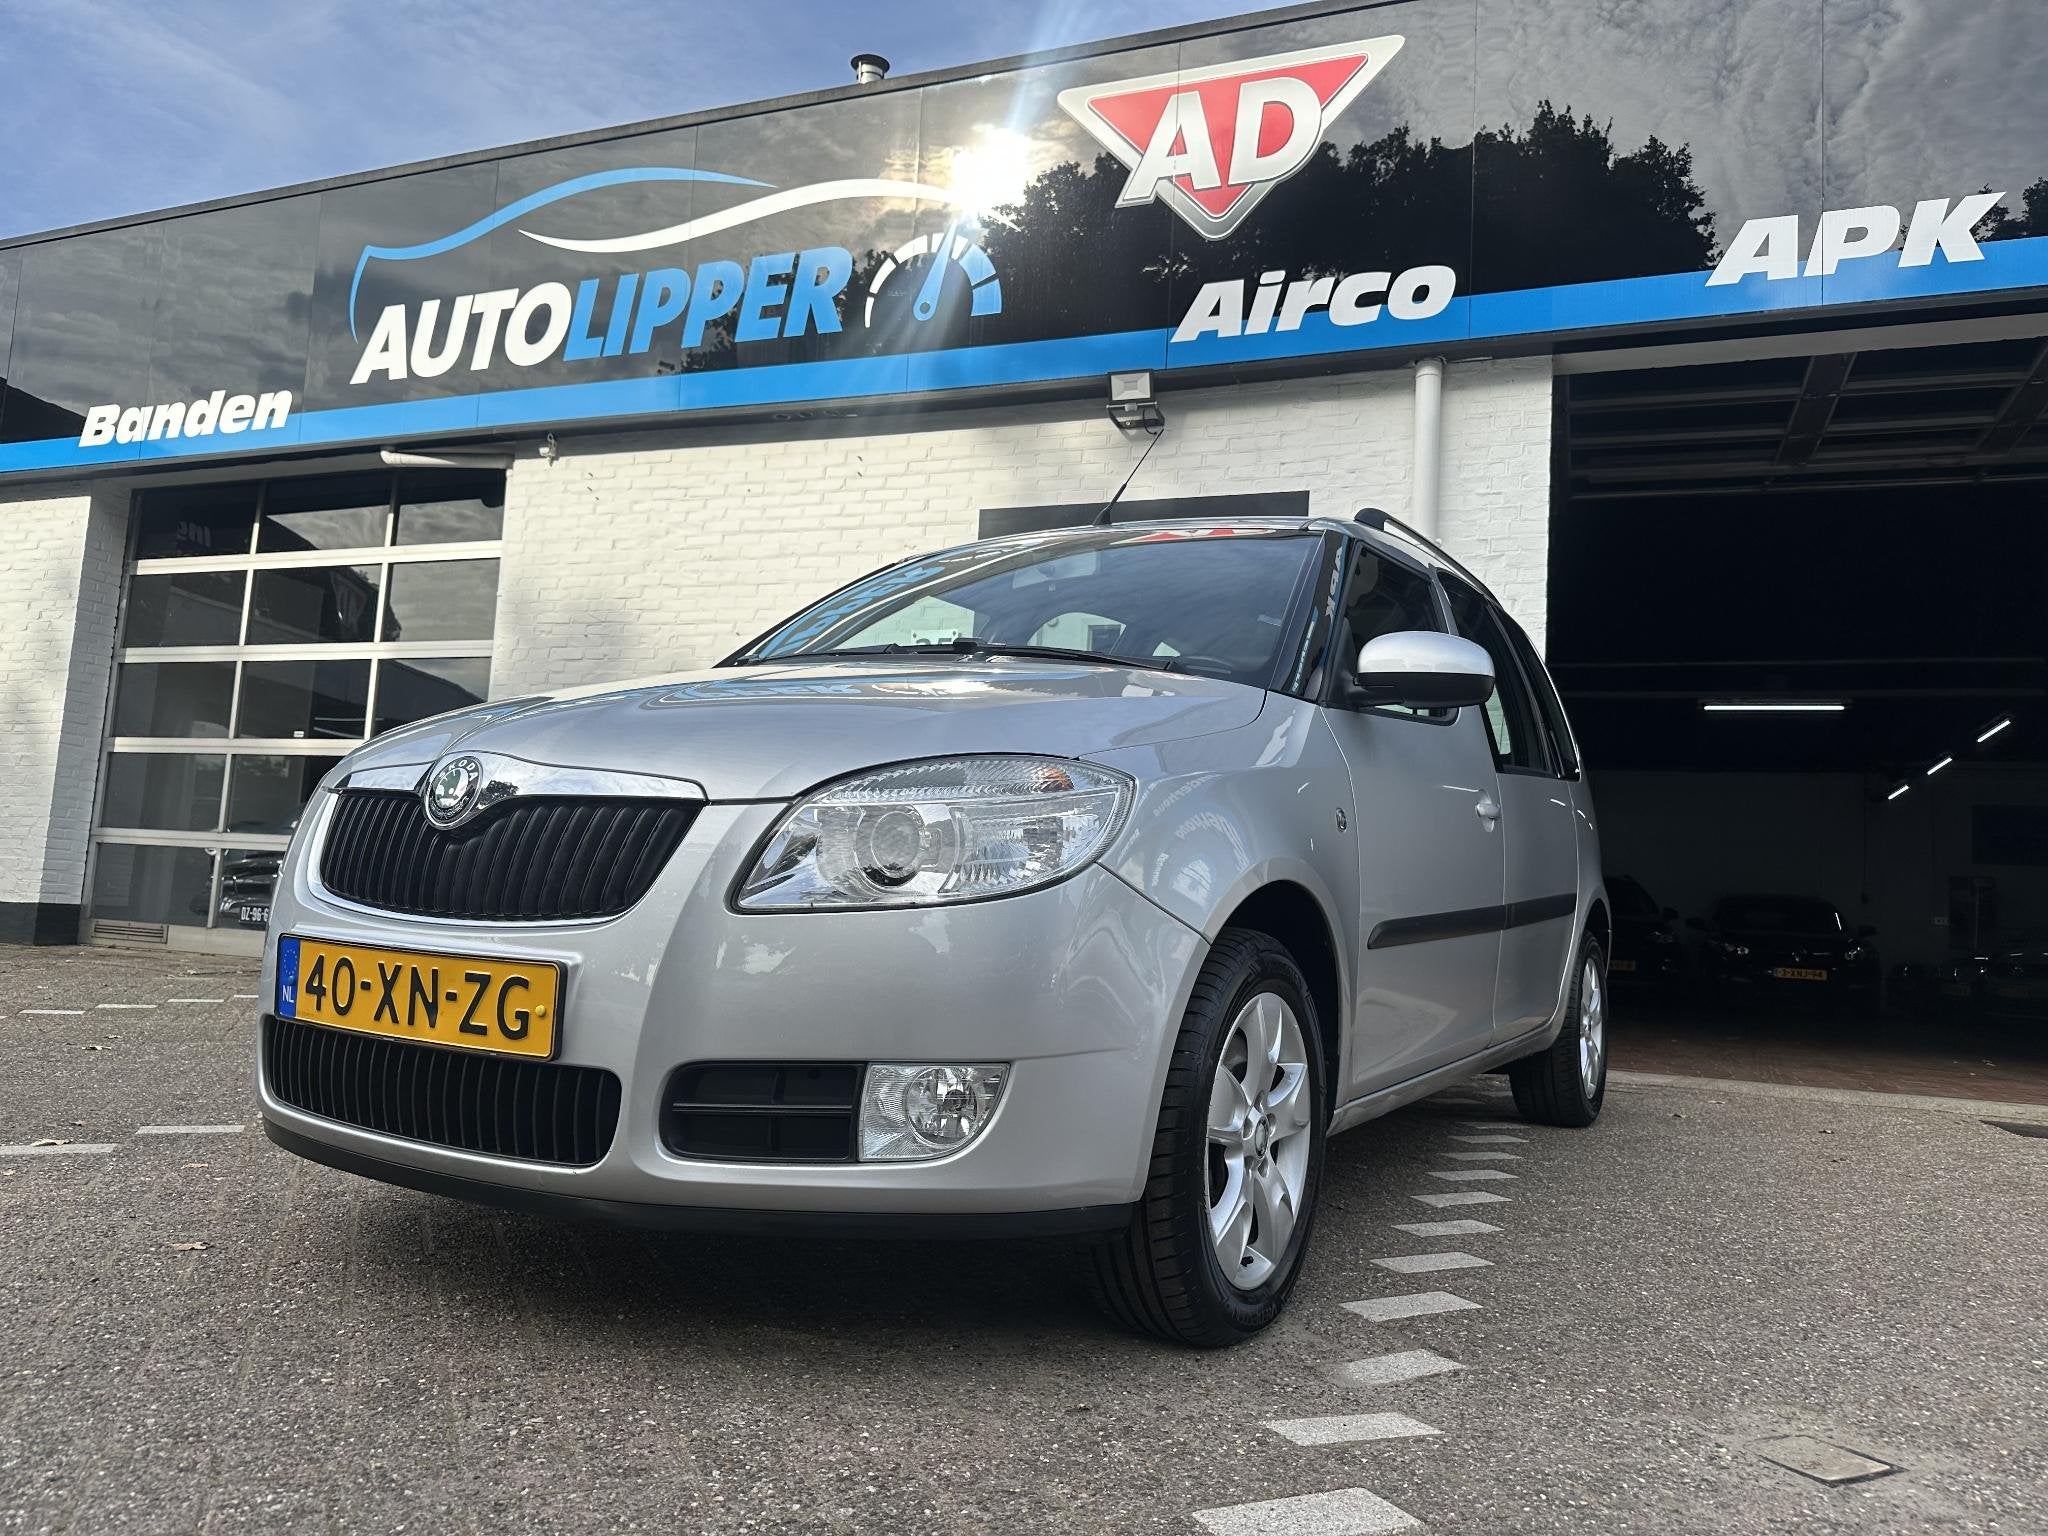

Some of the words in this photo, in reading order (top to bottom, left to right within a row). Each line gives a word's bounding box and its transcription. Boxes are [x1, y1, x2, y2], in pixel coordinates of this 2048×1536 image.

[1121, 76, 1322, 201] AD
[1705, 191, 2006, 287] APK
[349, 246, 853, 385] AUTOLIPPER
[1170, 264, 1457, 344] Airco
[78, 389, 293, 448] Banden
[241, 906, 269, 922] DZ-96-6
[282, 985, 296, 1003] NL
[305, 954, 532, 1041] 40-XN-ZG
